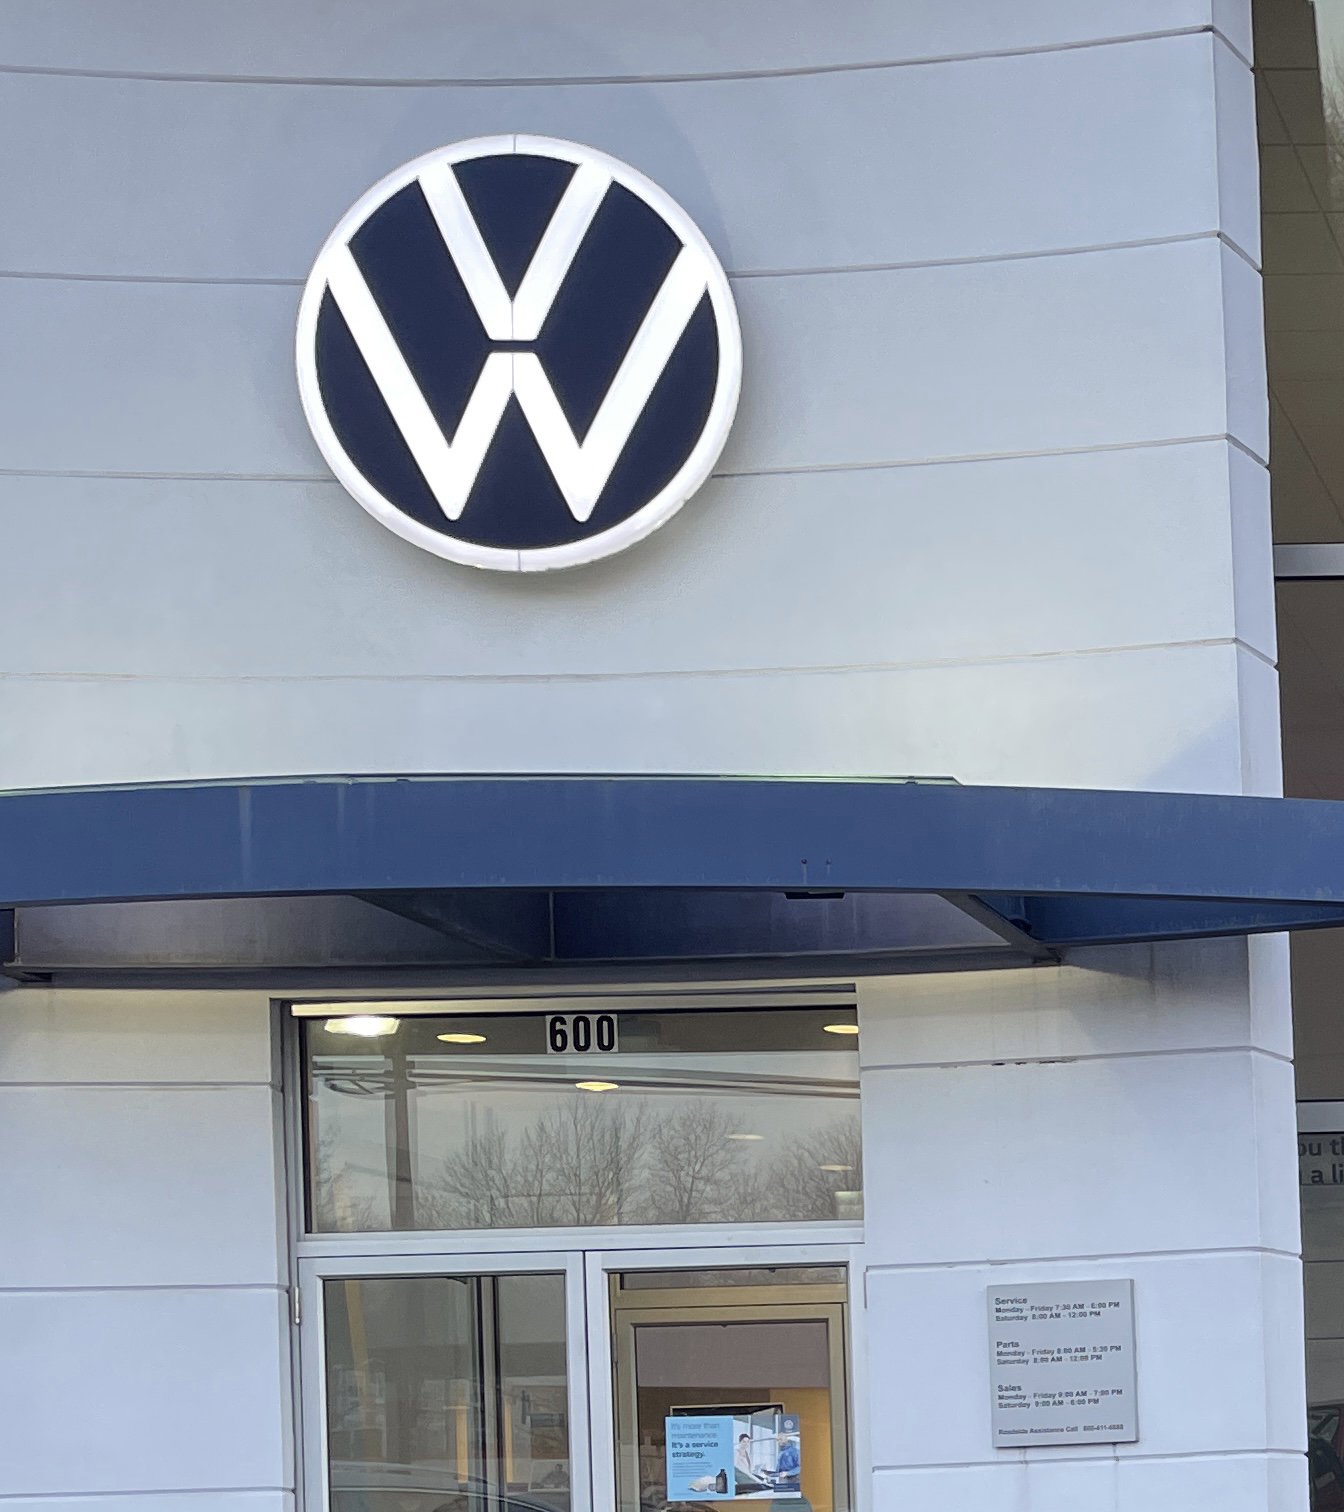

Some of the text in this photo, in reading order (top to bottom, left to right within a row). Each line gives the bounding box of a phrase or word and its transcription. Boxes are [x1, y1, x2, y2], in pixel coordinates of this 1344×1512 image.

[295, 133, 743, 572] VW
[550, 1016, 615, 1052] 600
[1311, 1170, 1324, 1184] a
[998, 1384, 1022, 1392] Sales
